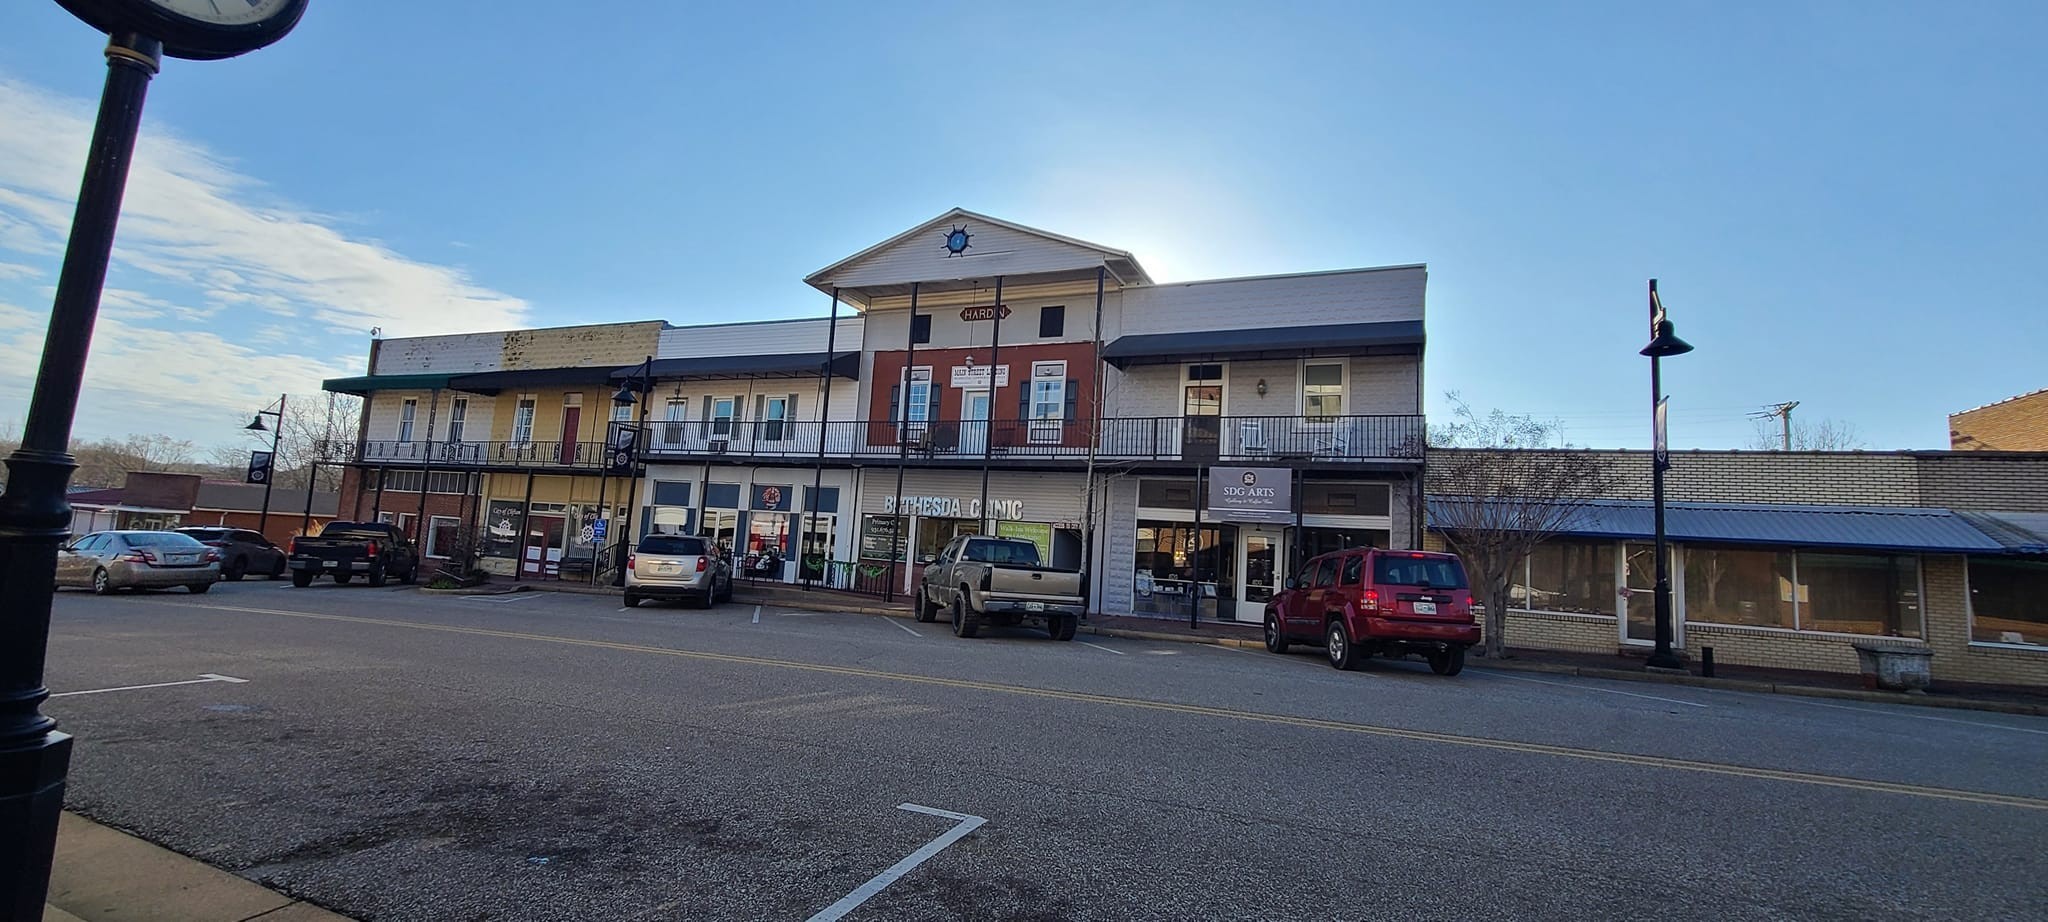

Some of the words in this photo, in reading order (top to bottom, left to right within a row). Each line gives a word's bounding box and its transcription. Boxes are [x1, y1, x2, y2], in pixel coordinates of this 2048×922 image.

[964, 308, 1006, 320] HARDN
[1223, 486, 1245, 496] SDG
[1248, 487, 1275, 497] ARTS
